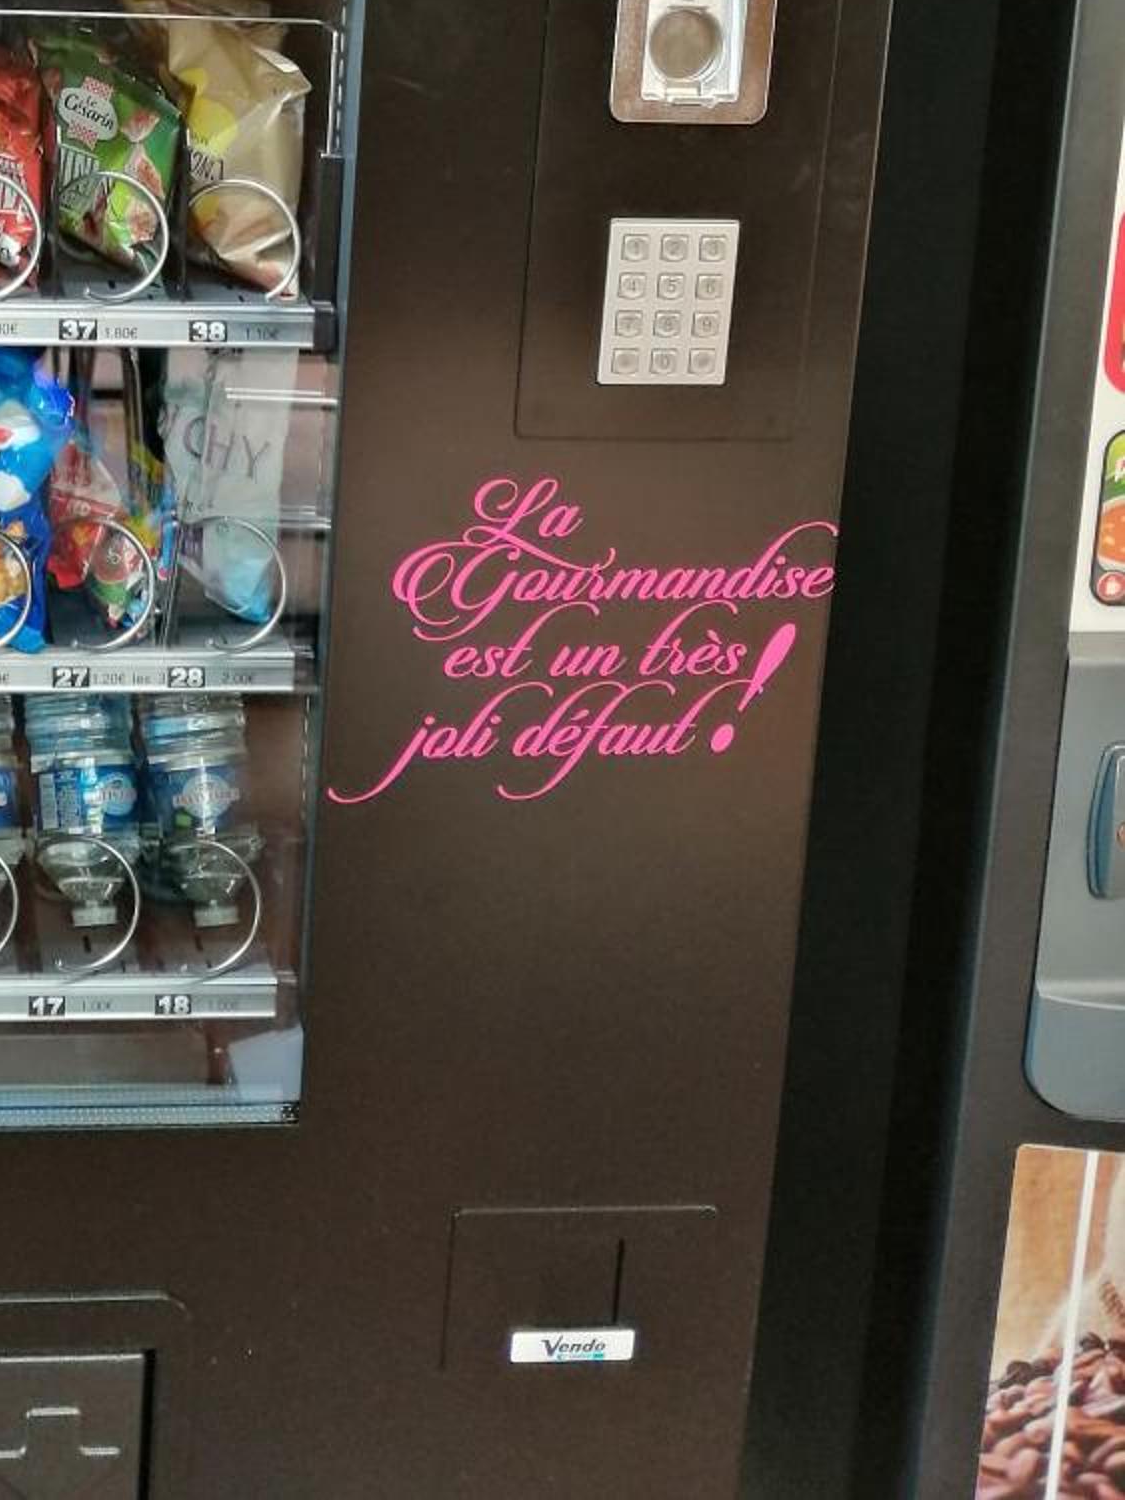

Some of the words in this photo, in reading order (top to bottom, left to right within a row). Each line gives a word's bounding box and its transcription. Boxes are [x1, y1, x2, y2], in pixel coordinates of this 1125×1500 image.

[61, 320, 96, 340] 37
[192, 321, 227, 342] 38
[463, 478, 616, 571] La
[393, 521, 839, 641] Gourmandise
[444, 601, 600, 678] est
[549, 643, 627, 678] un
[638, 599, 748, 677] très
[55, 668, 89, 687] 27
[170, 668, 204, 687] 28
[328, 681, 554, 804] joli
[496, 679, 763, 801] défaut
[32, 996, 65, 1015] 17
[158, 995, 191, 1014] 18
[540, 1334, 606, 1357] Vendo
